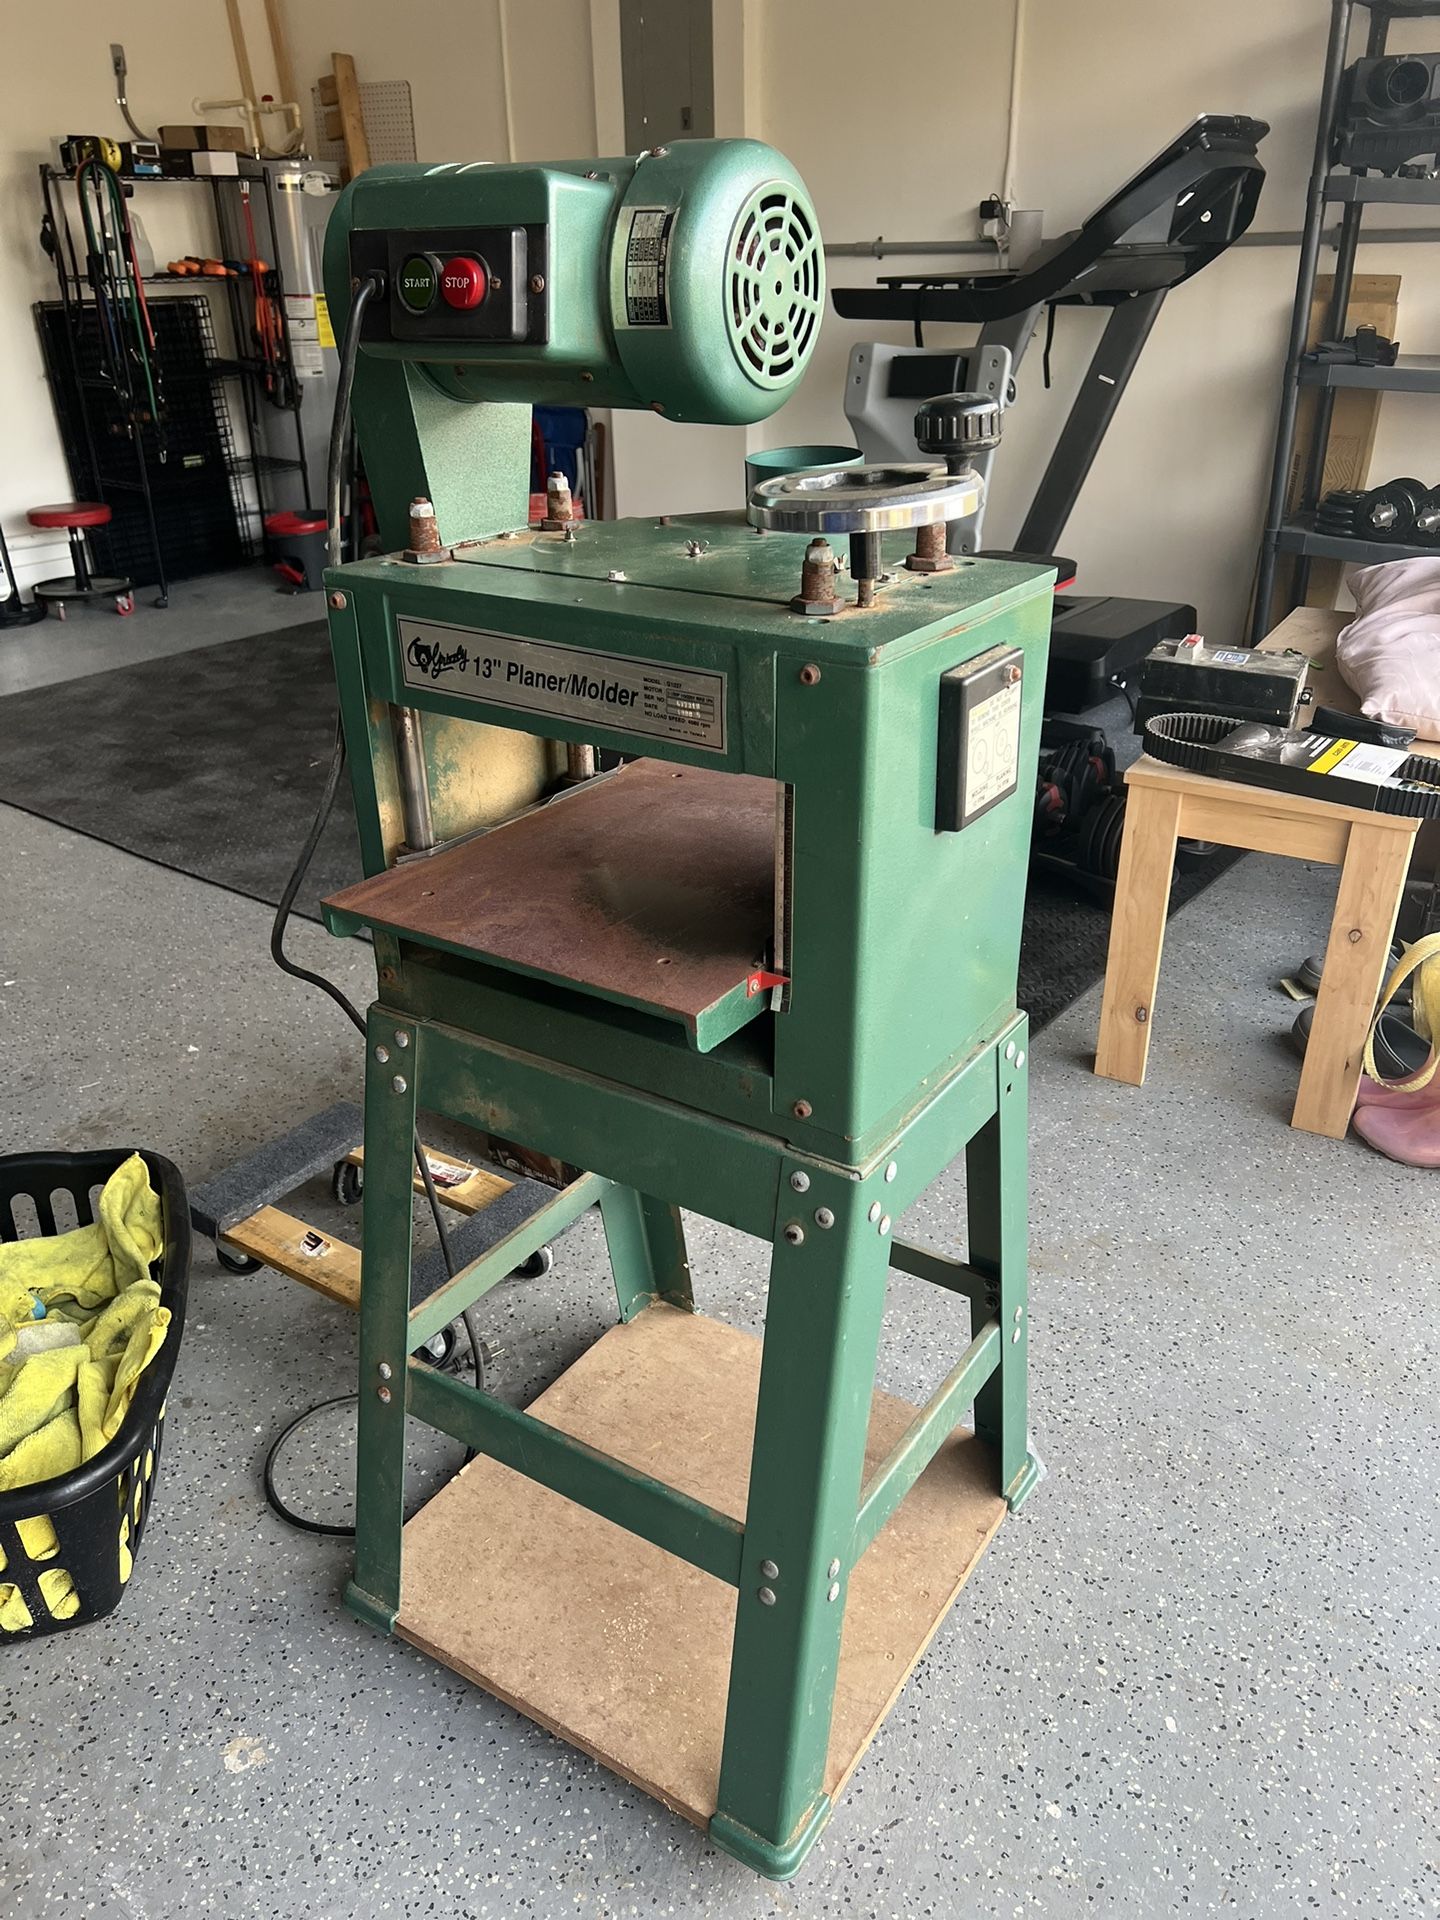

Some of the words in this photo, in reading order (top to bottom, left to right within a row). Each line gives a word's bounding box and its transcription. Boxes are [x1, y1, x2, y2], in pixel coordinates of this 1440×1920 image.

[404, 278, 430, 288] START
[445, 276, 470, 288] STOP
[473, 656, 501, 678] 13"
[506, 661, 639, 707] Planer/Molder
